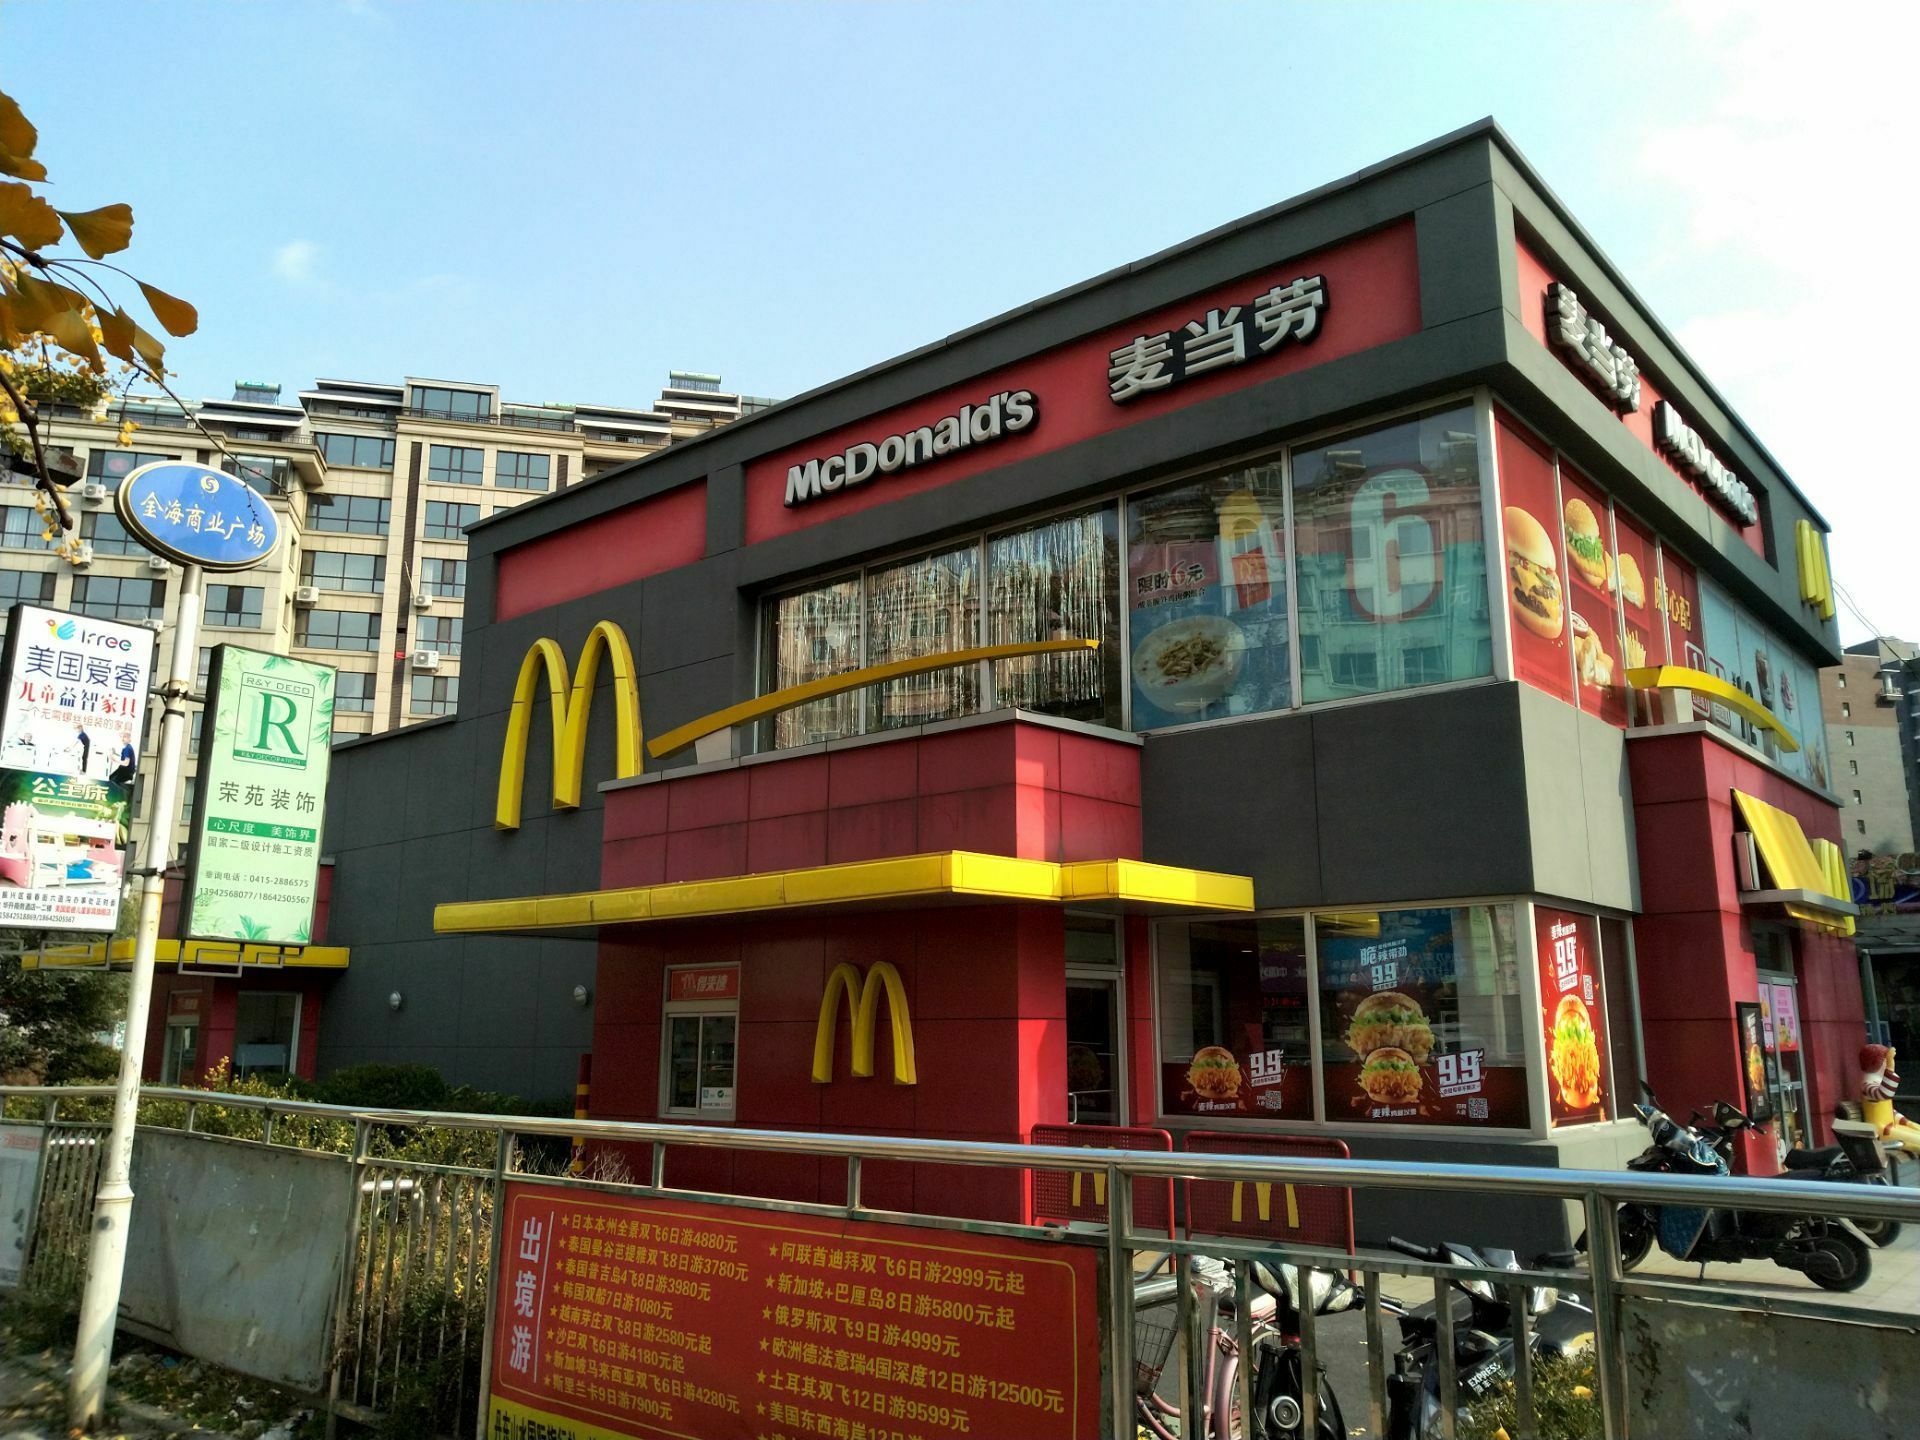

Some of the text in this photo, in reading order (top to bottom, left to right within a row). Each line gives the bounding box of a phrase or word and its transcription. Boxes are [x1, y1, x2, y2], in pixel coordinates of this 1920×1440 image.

[1108, 275, 1328, 404] 麦当劳
[784, 388, 1039, 507] McDonald's
[140, 492, 266, 548] 金海商业广场
[25, 645, 140, 692] 美国爱睿
[246, 677, 310, 695] R&Y DECO
[19, 681, 136, 718] 儿童益智家具
[253, 692, 304, 755] R
[32, 776, 109, 801] 公主床
[218, 781, 316, 813] 荣苑装饰
[207, 836, 313, 858] 国家二级设计施工资质
[214, 819, 310, 841] 心尺度 美饰界
[571, 1213, 738, 1254] 日本本州全景双飞6日游4880元
[565, 1258, 712, 1302] 泰国普吉岛4飞8日游3980元
[781, 1242, 1026, 1295] 阿联酋迪拜双飞6日游2999元起
[510, 1216, 542, 1374] 出境游
[563, 1281, 674, 1321] 韩国双船7日游1080元
[777, 1273, 1016, 1331] 新加坡+巴厘岛8日游5800元起
[556, 1327, 685, 1374] 沙巴双飞6日游4180元起
[559, 1303, 713, 1356] 越南芽庄双飞8日游2580元起
[774, 1304, 961, 1359] 俄罗斯双飞9日游4999元
[552, 1373, 674, 1421] 斯里兰卡9日游7900元
[553, 1350, 741, 1415] 新加坡马来西亚双飞6日游4280元
[772, 1336, 1065, 1414] 欧洲德法意瑞4国深度12日游12500元
[769, 1369, 971, 1433] 土耳其双飞12日游9599元
